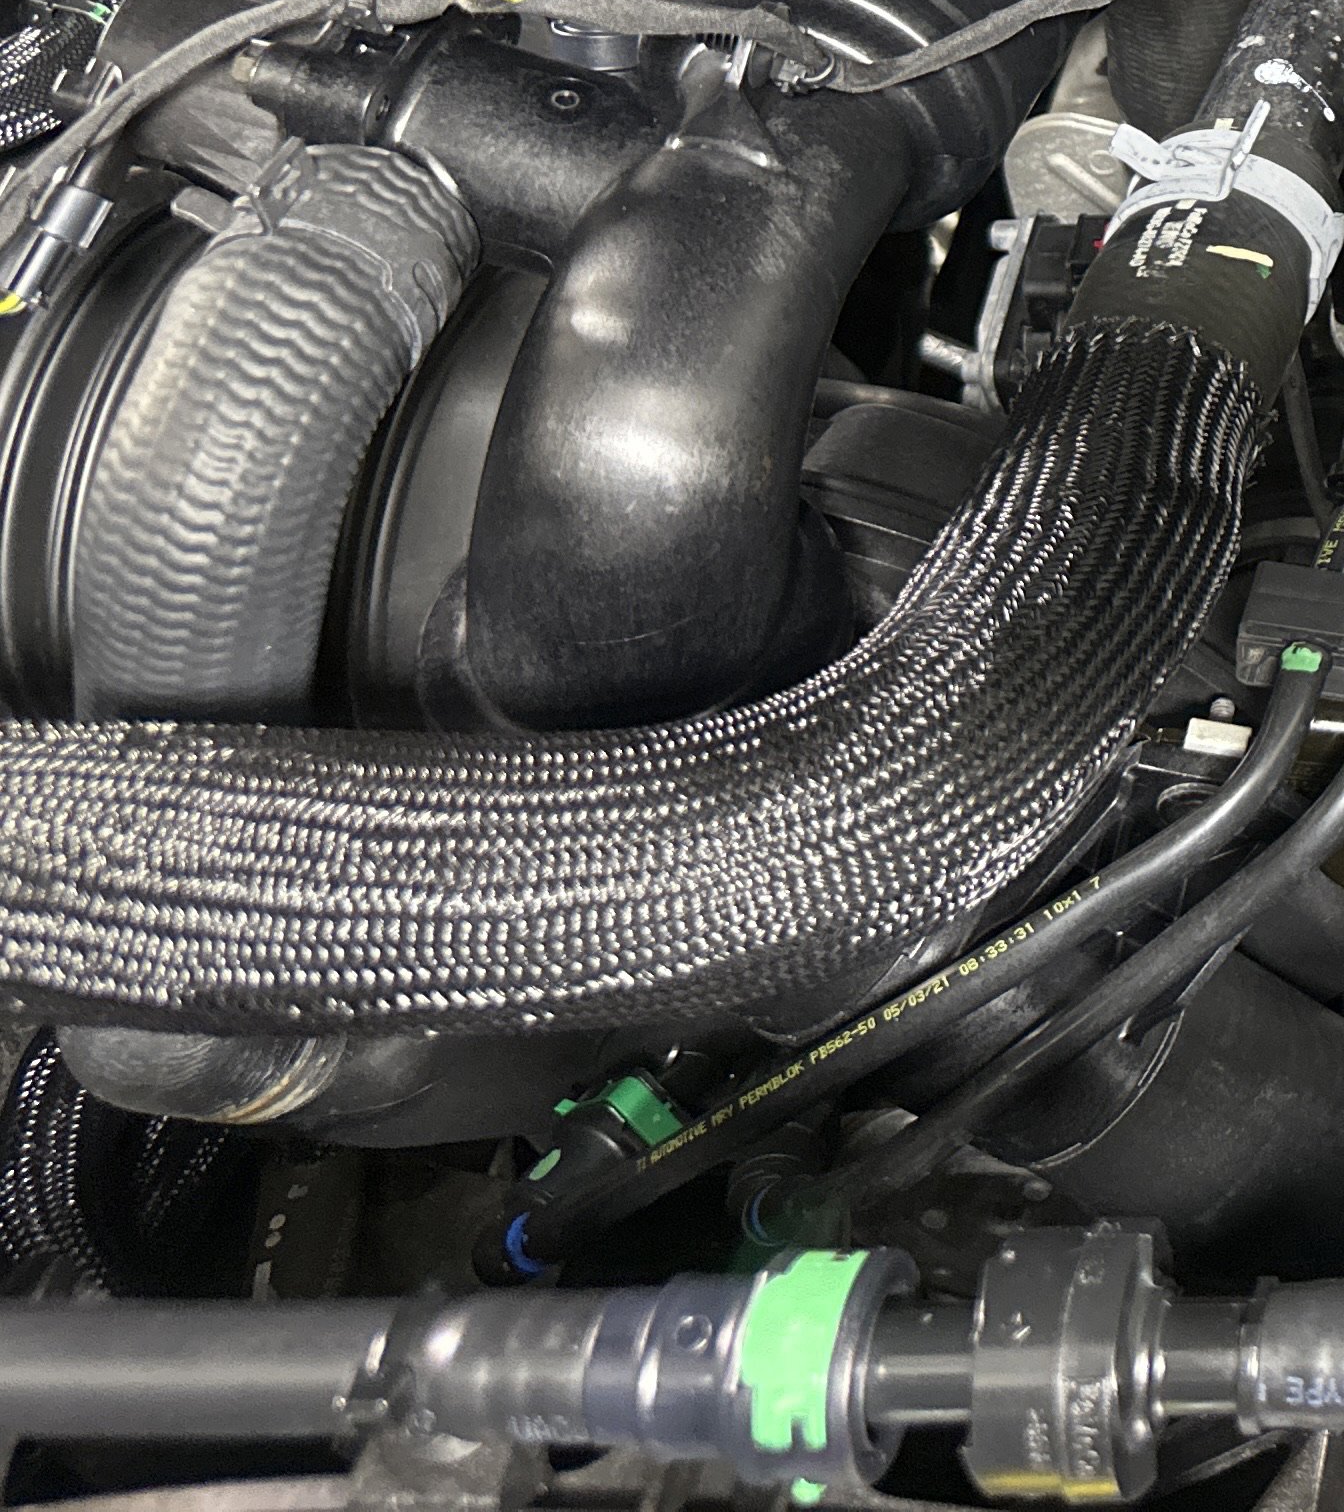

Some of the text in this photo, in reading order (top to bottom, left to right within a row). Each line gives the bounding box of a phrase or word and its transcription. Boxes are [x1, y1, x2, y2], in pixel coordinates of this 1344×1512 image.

[711, 1107, 734, 1128] MRY
[738, 1060, 805, 1110] PERMBLOK
[810, 1016, 877, 1065] PB562-50
[883, 976, 950, 1021] 05/03/21
[958, 921, 1035, 977] 08:33:31
